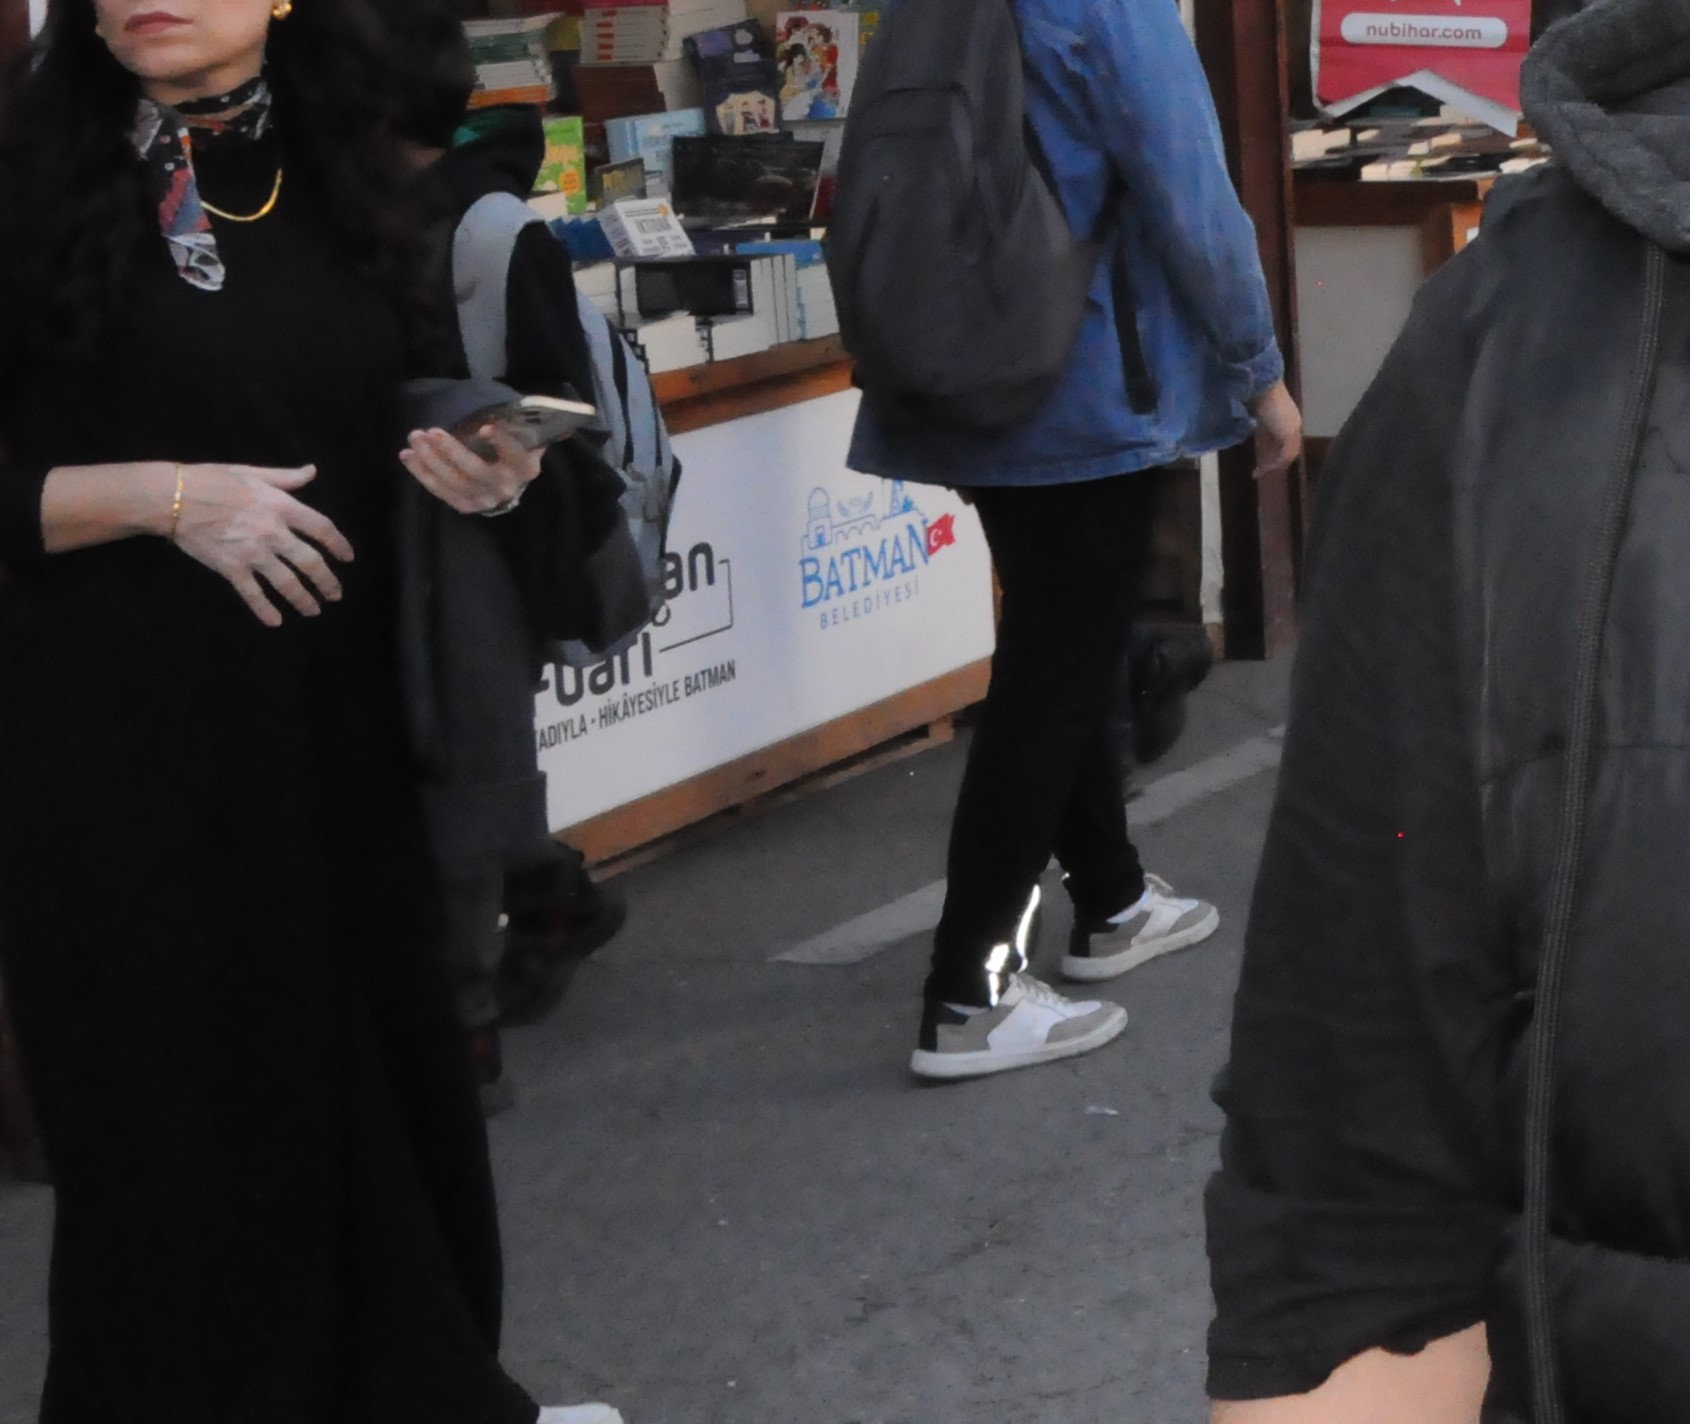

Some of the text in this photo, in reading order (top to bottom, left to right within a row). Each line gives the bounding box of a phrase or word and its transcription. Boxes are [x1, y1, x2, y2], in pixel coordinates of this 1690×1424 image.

[1366, 23, 1482, 41] nubihar.com
[799, 518, 930, 609] BATMAN
[819, 575, 920, 630] BELEDİYESİ
[535, 659, 737, 752] ADIYLA HİKÂYESİYLE BATMAN
